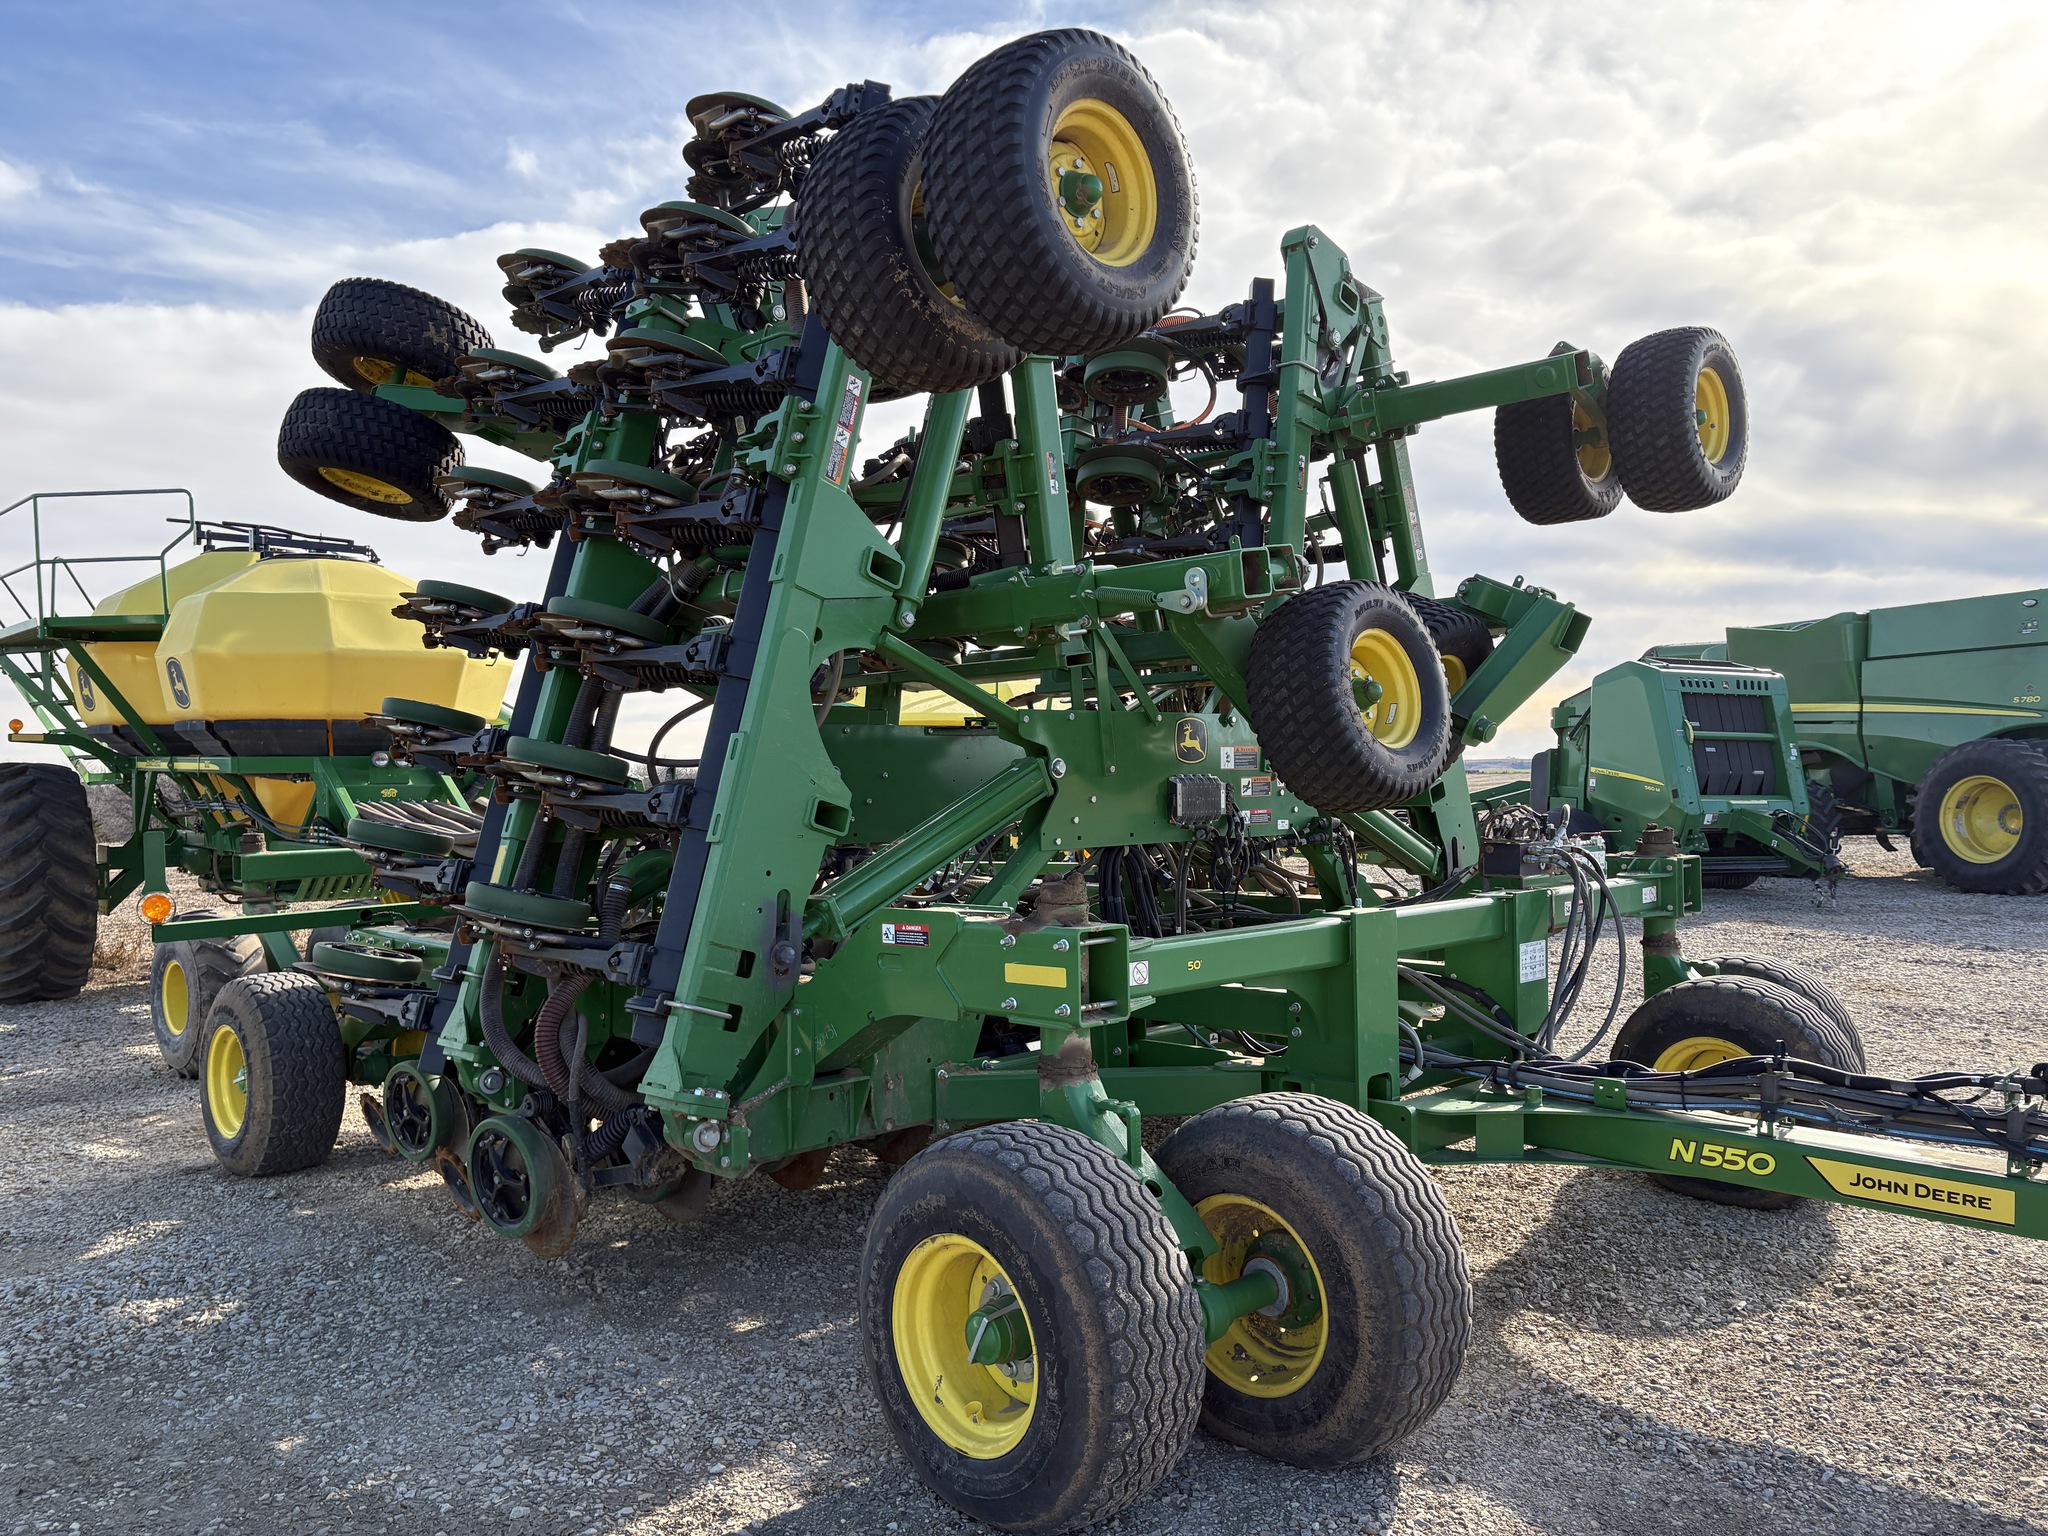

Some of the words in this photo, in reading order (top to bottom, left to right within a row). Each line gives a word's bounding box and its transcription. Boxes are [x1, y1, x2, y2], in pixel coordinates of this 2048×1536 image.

[1354, 598, 1384, 621] MULTI
[1386, 600, 1419, 629] TRAC
[1849, 1172, 1909, 1196] JOHN
[1914, 1183, 1992, 1210] DEERE
